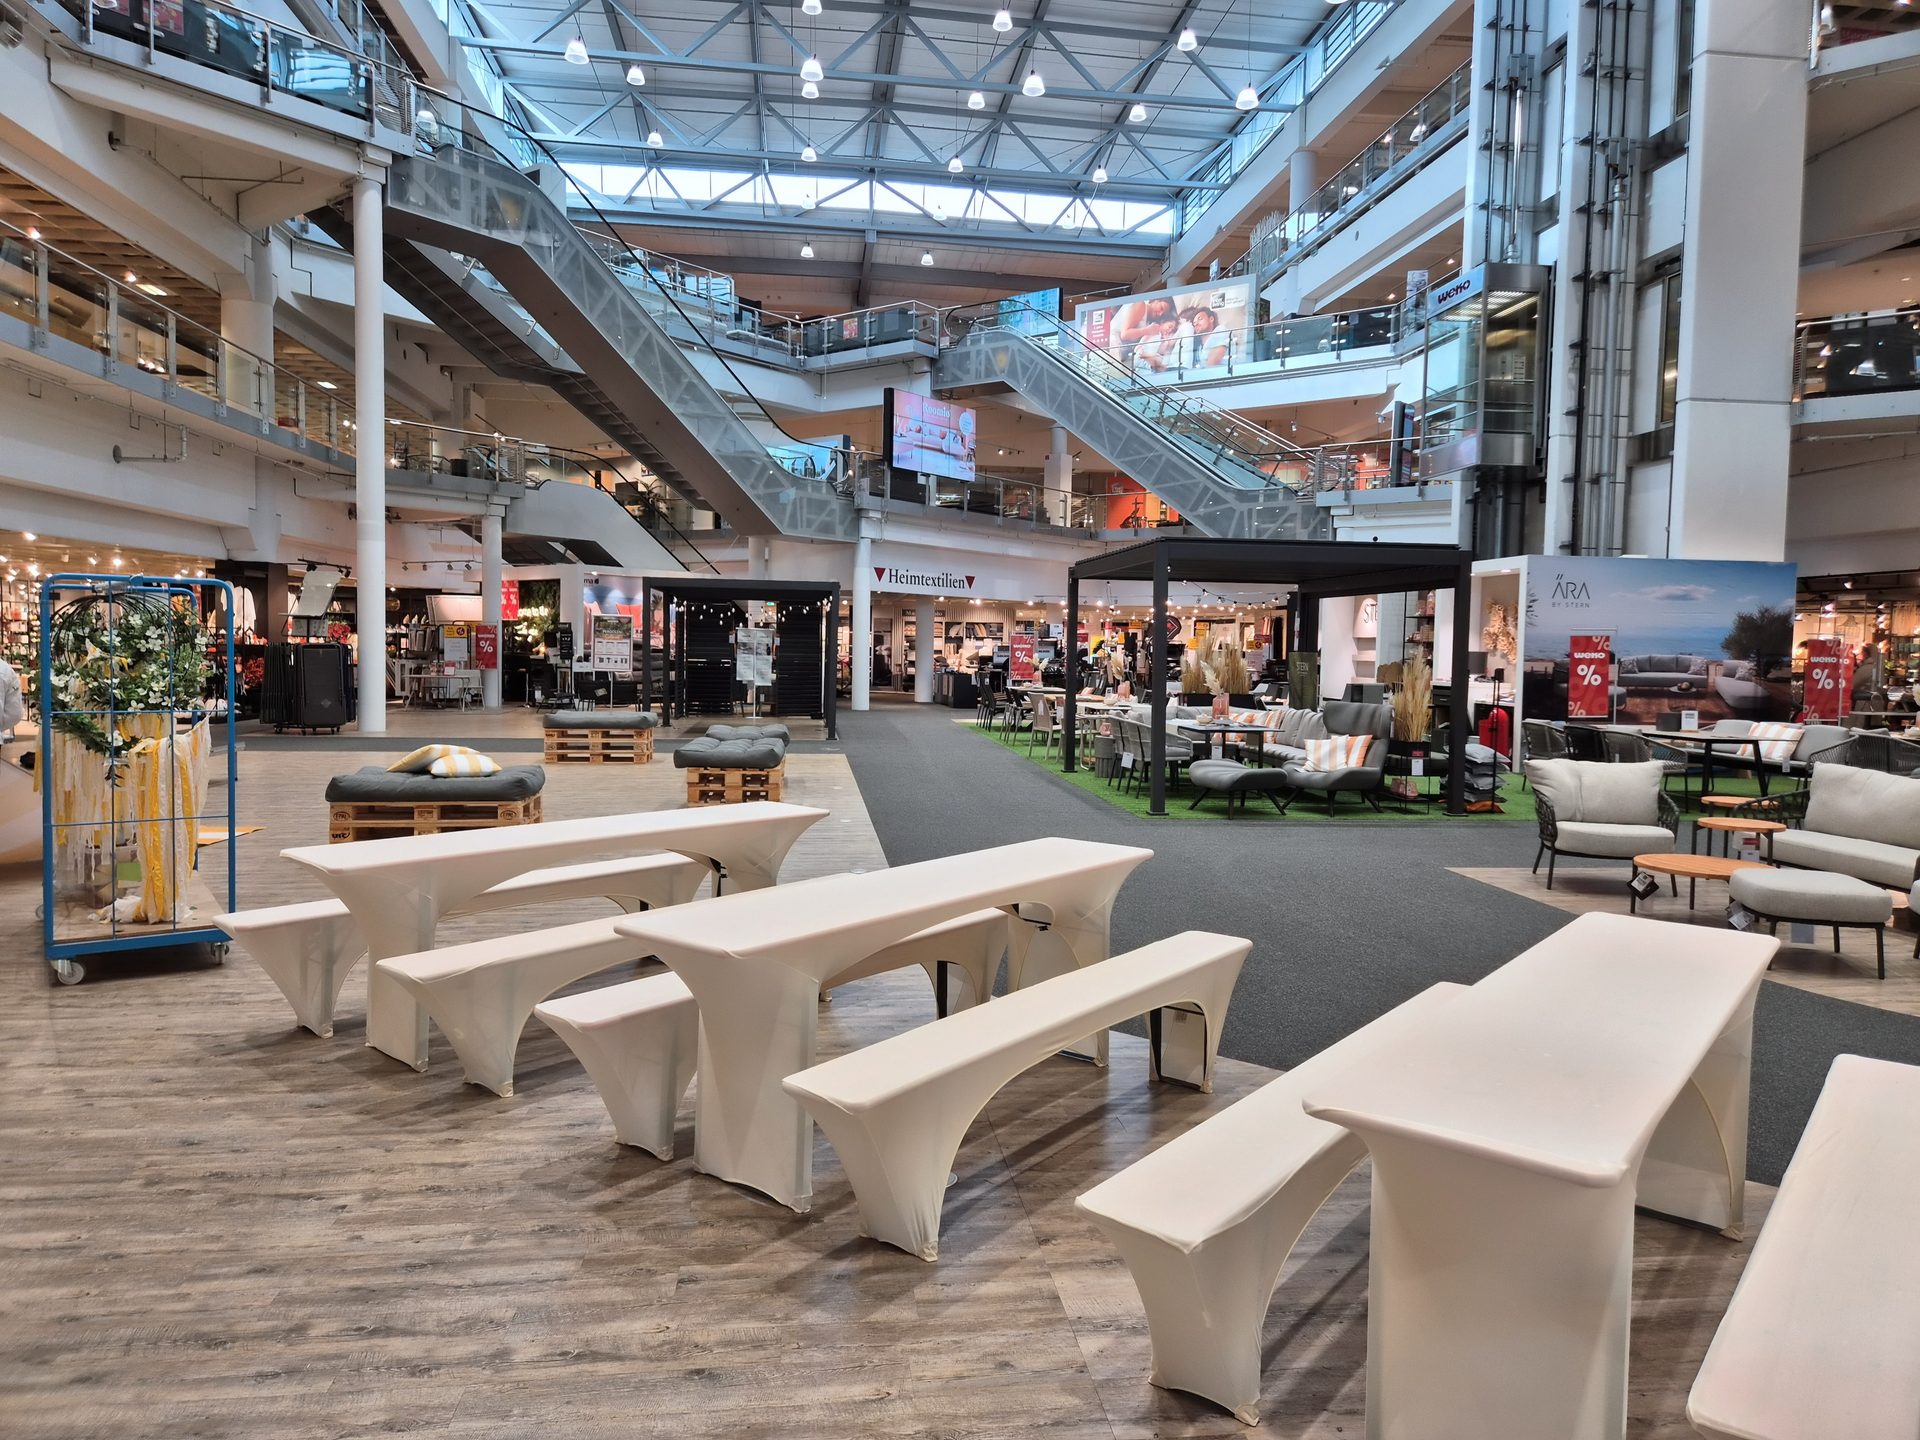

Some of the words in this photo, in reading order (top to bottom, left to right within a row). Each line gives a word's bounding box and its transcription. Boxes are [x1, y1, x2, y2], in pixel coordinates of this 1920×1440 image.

[888, 568, 966, 590] Heimtextilien
[1551, 573, 1591, 600] ÄRA
[1576, 664, 1602, 686] %
[1812, 669, 1834, 690] %
